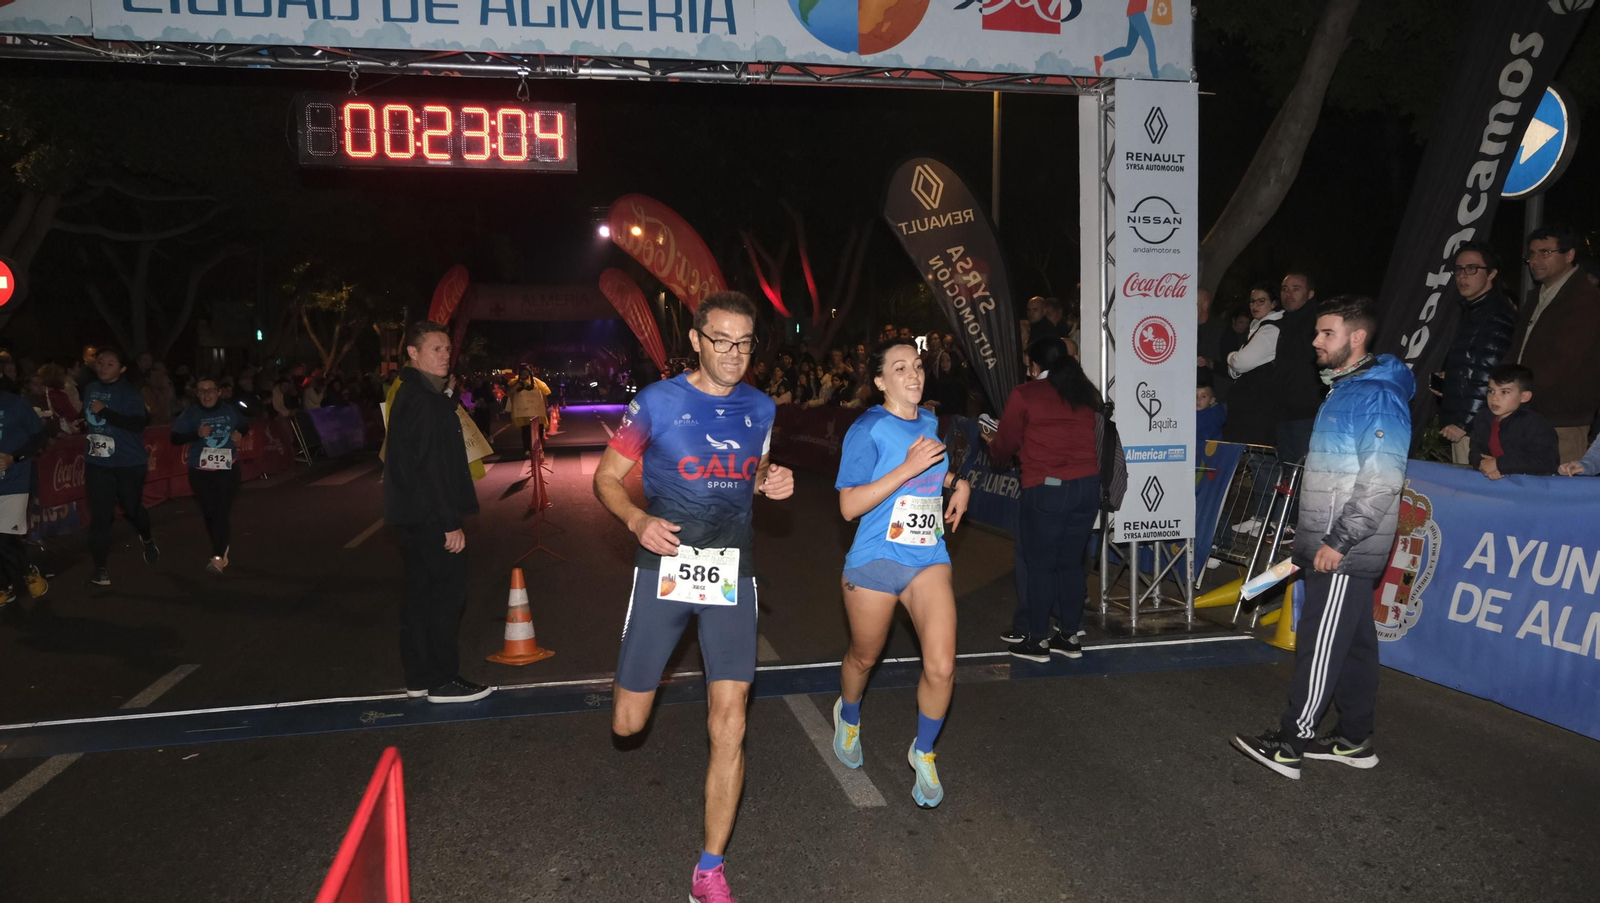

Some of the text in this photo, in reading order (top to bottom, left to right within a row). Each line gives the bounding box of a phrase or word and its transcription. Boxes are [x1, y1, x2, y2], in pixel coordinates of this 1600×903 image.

[383, 0, 459, 25] DE
[343, 102, 564, 162] 00:23:04
[1126, 151, 1185, 163] RENAULT
[1126, 163, 1185, 172] SYRSA AUTOMOCION
[1127, 215, 1182, 225] NISSAN
[1132, 246, 1181, 254] andalmotor.es
[1123, 272, 1191, 298] Coca-Cola
[207, 454, 226, 462] 612
[1126, 448, 1167, 461] Almericar
[707, 481, 739, 489] SPORT
[966, 469, 982, 489] DE
[906, 513, 936, 529] 330
[1123, 519, 1181, 531] RENAULT
[1124, 530, 1181, 540] SYRSA AUTOMOCION
[678, 563, 720, 584] 586
[1410, 572, 1431, 601] LIBERTAD
[1448, 581, 1513, 634] DE
